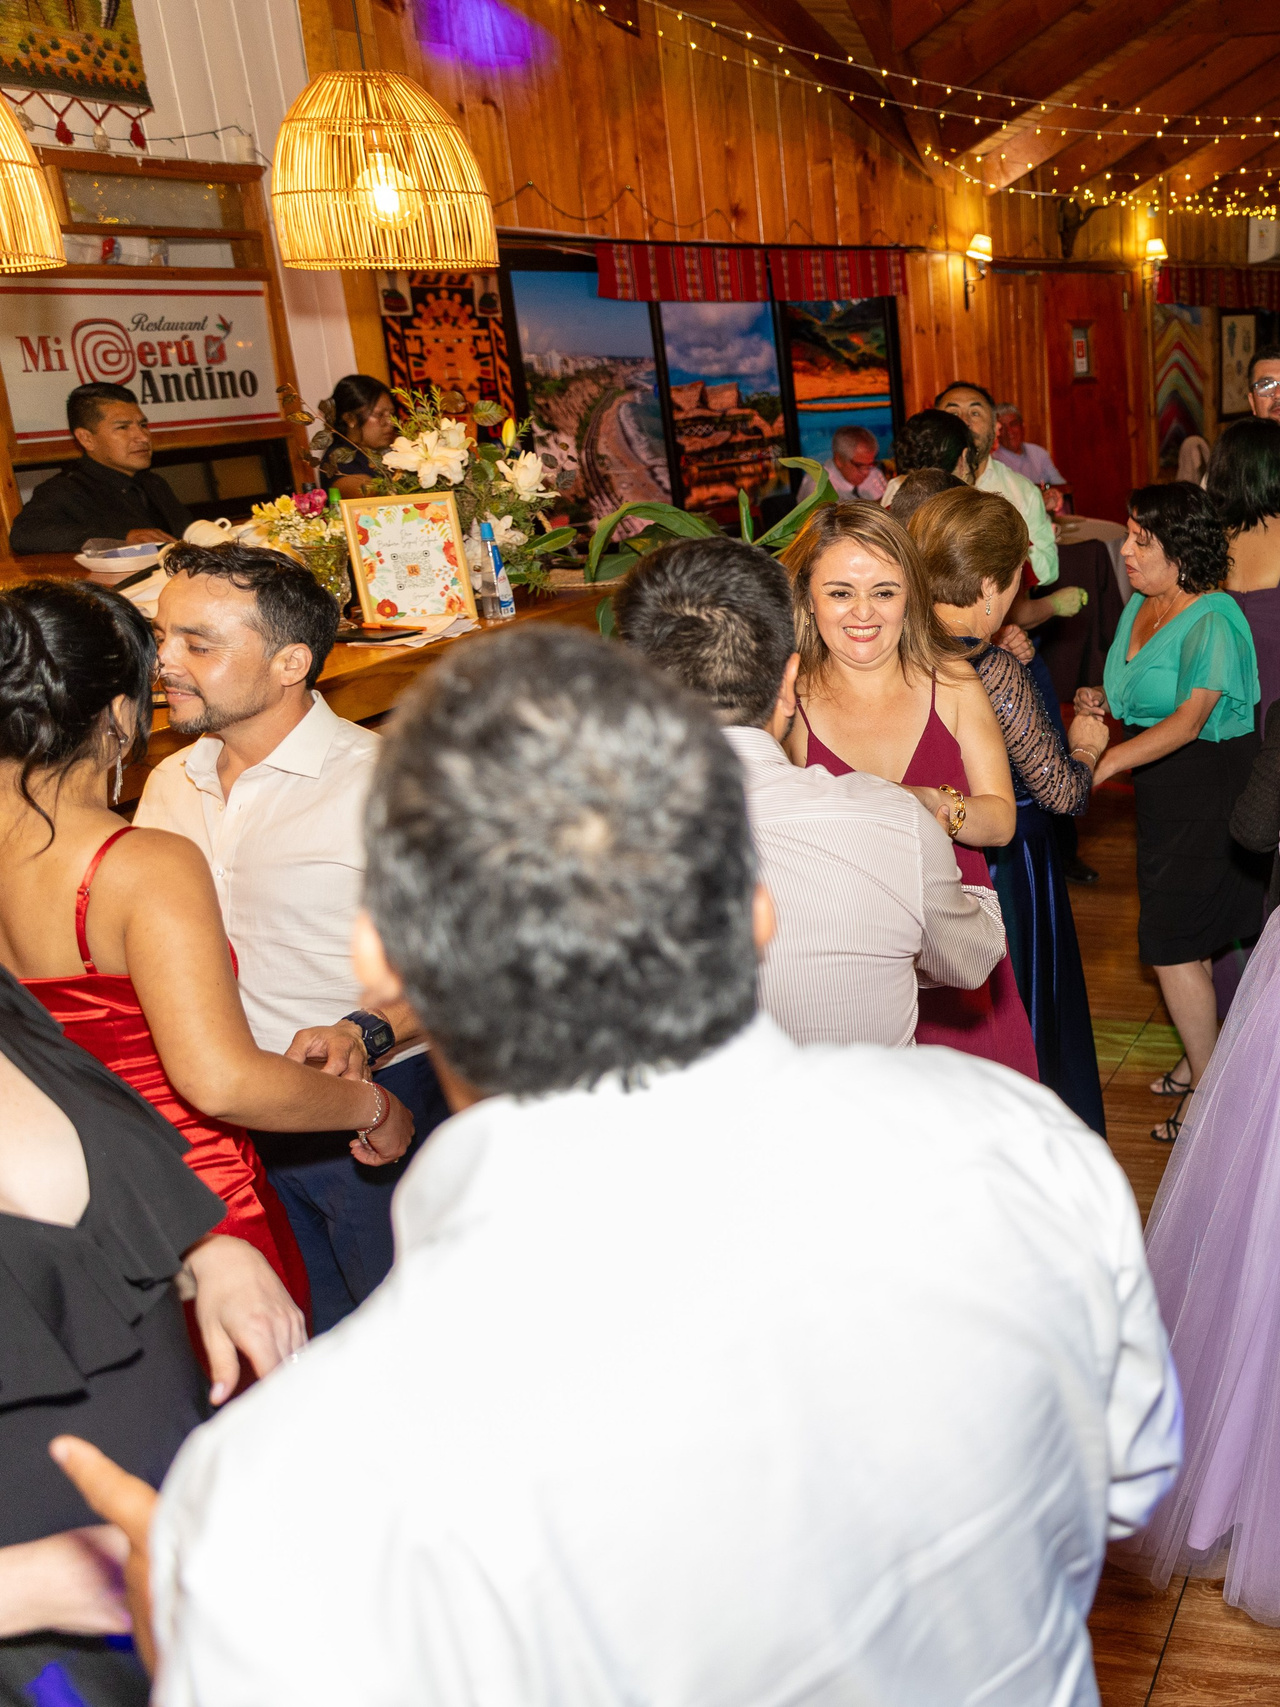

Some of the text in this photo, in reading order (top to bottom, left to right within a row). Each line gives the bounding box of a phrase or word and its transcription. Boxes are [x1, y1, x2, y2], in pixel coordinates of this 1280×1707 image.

[127, 313, 208, 333] Restaurant
[15, 335, 69, 373] Mi
[140, 367, 258, 405] Andino
